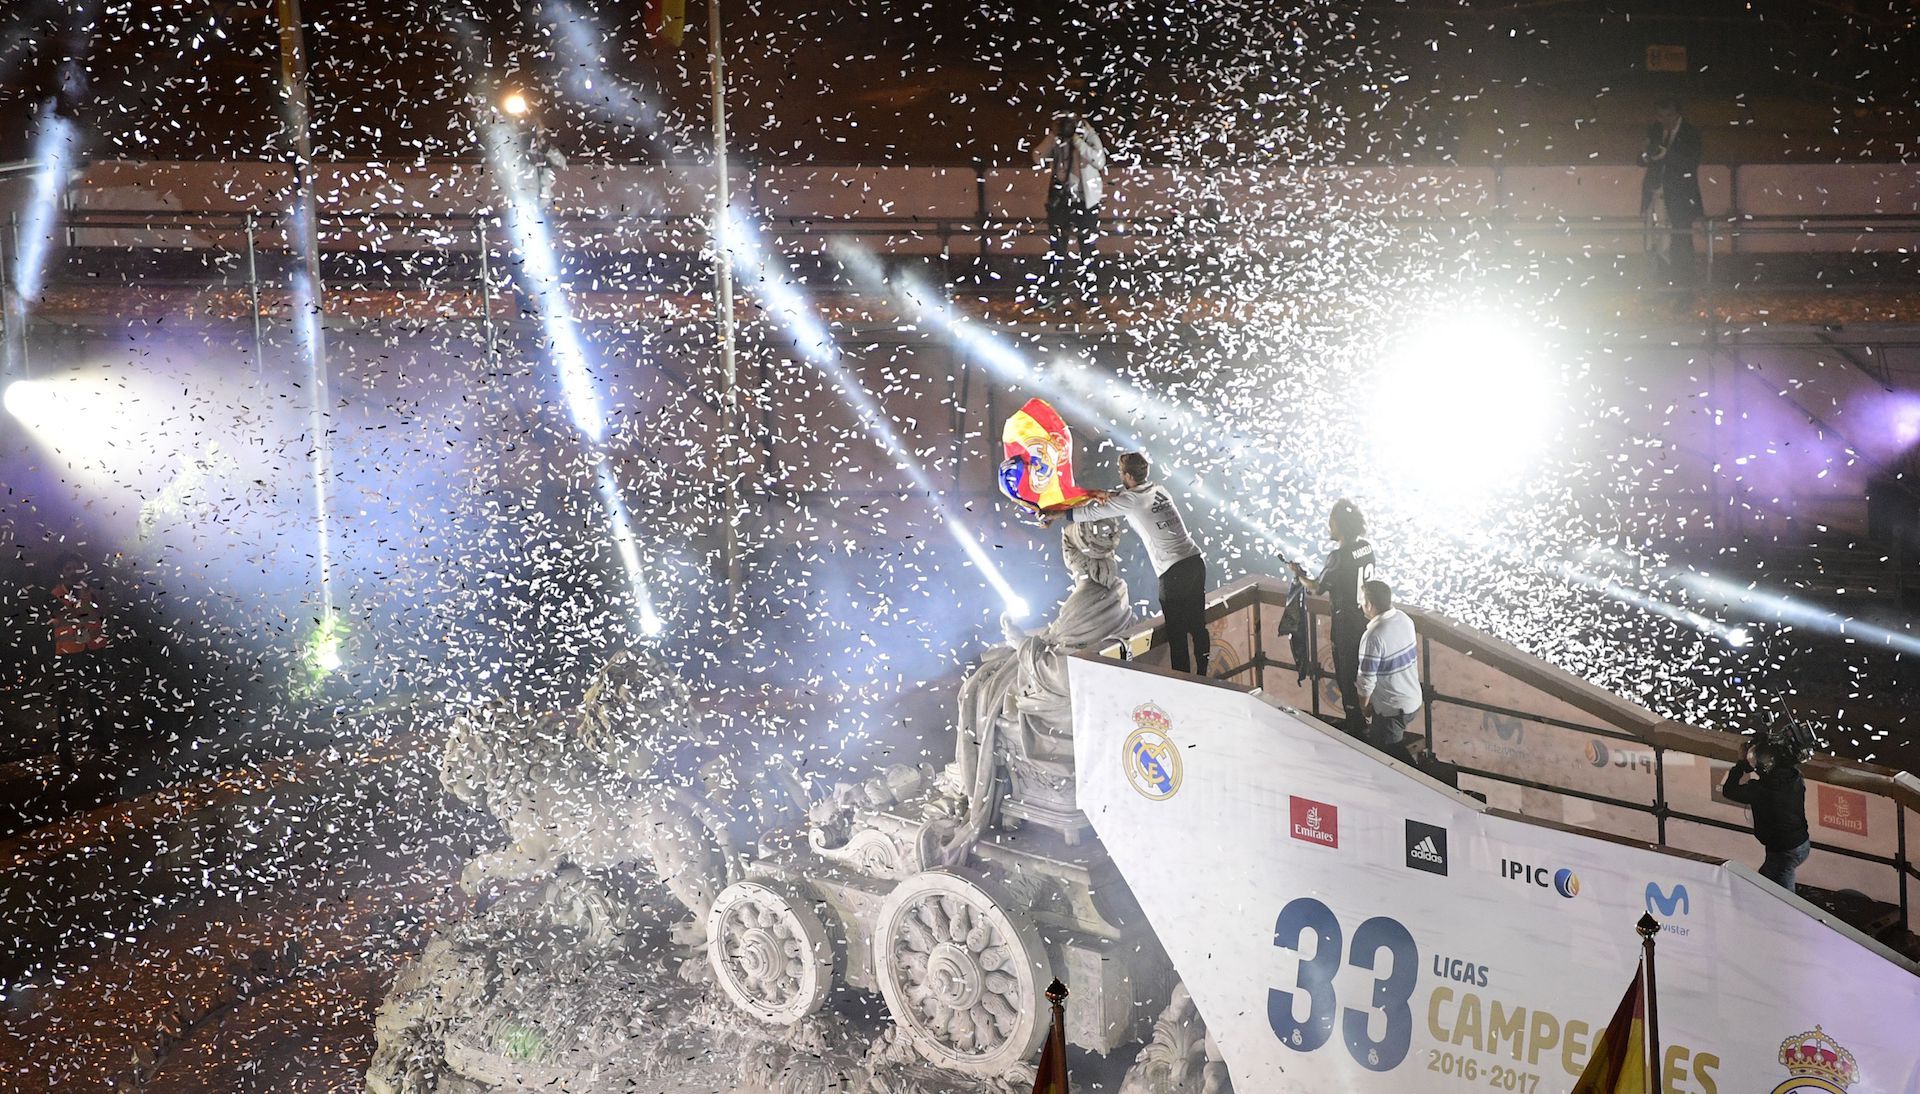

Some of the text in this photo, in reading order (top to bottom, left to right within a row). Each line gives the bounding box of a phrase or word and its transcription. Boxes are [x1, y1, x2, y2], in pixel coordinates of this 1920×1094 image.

[1295, 823, 1334, 842] Emirates
[1410, 848, 1443, 864] adidas
[1501, 858, 1549, 888] IPIC
[1659, 922, 1690, 937] vistar
[1267, 897, 1419, 1072] 33
[1433, 954, 1489, 988] LIGAS
[1427, 986, 1720, 1094] CAMPEES
